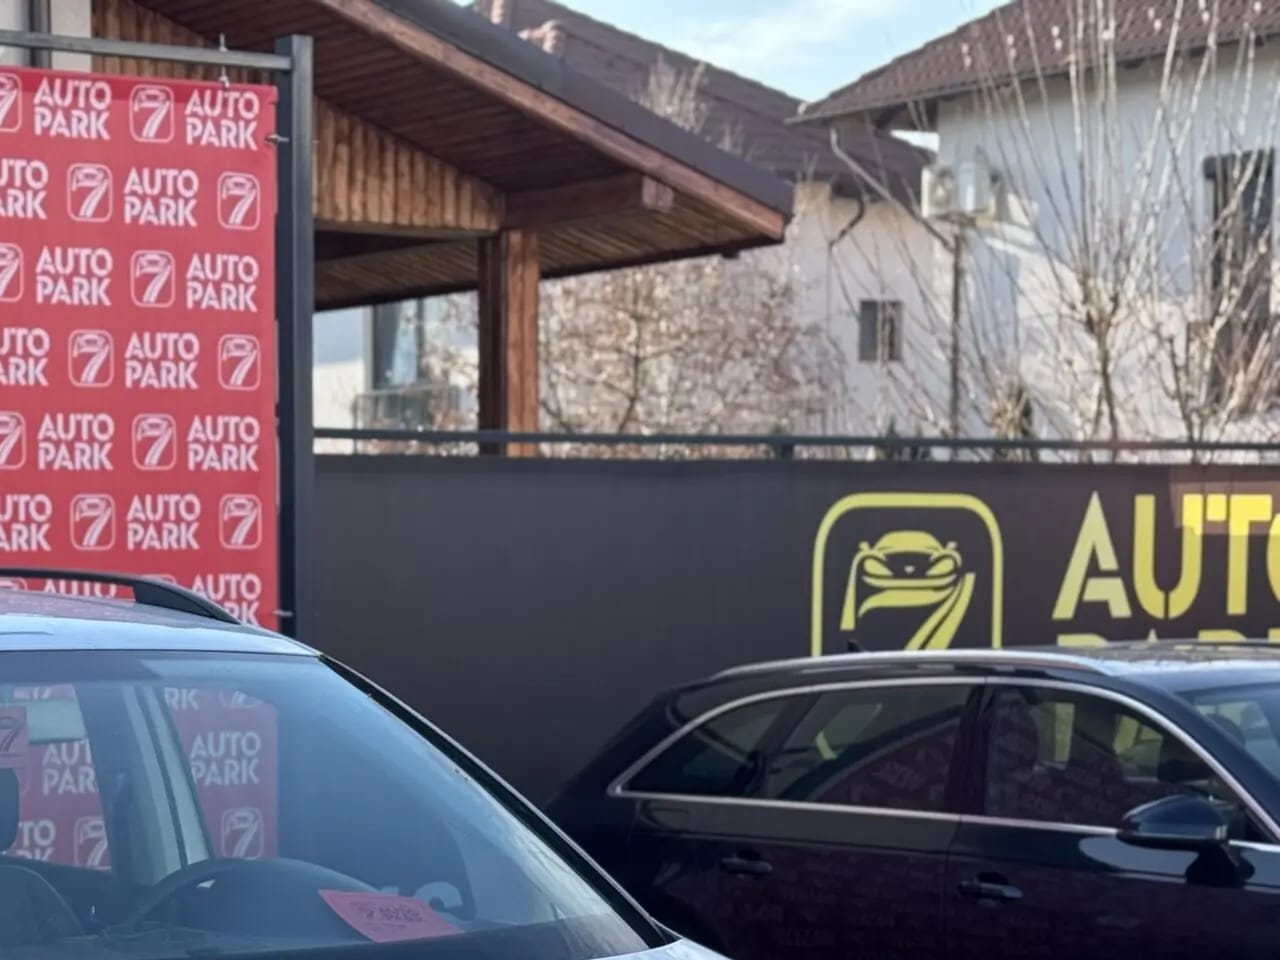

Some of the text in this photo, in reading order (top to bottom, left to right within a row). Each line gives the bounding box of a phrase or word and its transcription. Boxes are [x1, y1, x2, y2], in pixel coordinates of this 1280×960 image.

[34, 79, 111, 108] AUTO
[185, 90, 260, 117] AUTO
[35, 106, 110, 139] PARK
[186, 116, 257, 149] PARK
[124, 167, 198, 197] AUTO
[124, 195, 197, 225] PARK
[36, 247, 113, 276] AUTO
[186, 254, 259, 281] AUTO
[36, 275, 112, 304] PARK
[186, 280, 258, 310] PARK
[125, 332, 199, 360] AUTO
[126, 360, 198, 389] PARK
[37, 412, 113, 441] AUTO
[187, 415, 260, 443] AUTO
[38, 441, 113, 469] PARK
[188, 442, 259, 470] PARK
[127, 493, 200, 521] AUTO
[128, 519, 199, 549] PARK
[1052, 490, 1280, 619] AUT
[190, 732, 261, 760] AUTO
[191, 758, 260, 787] PARK
